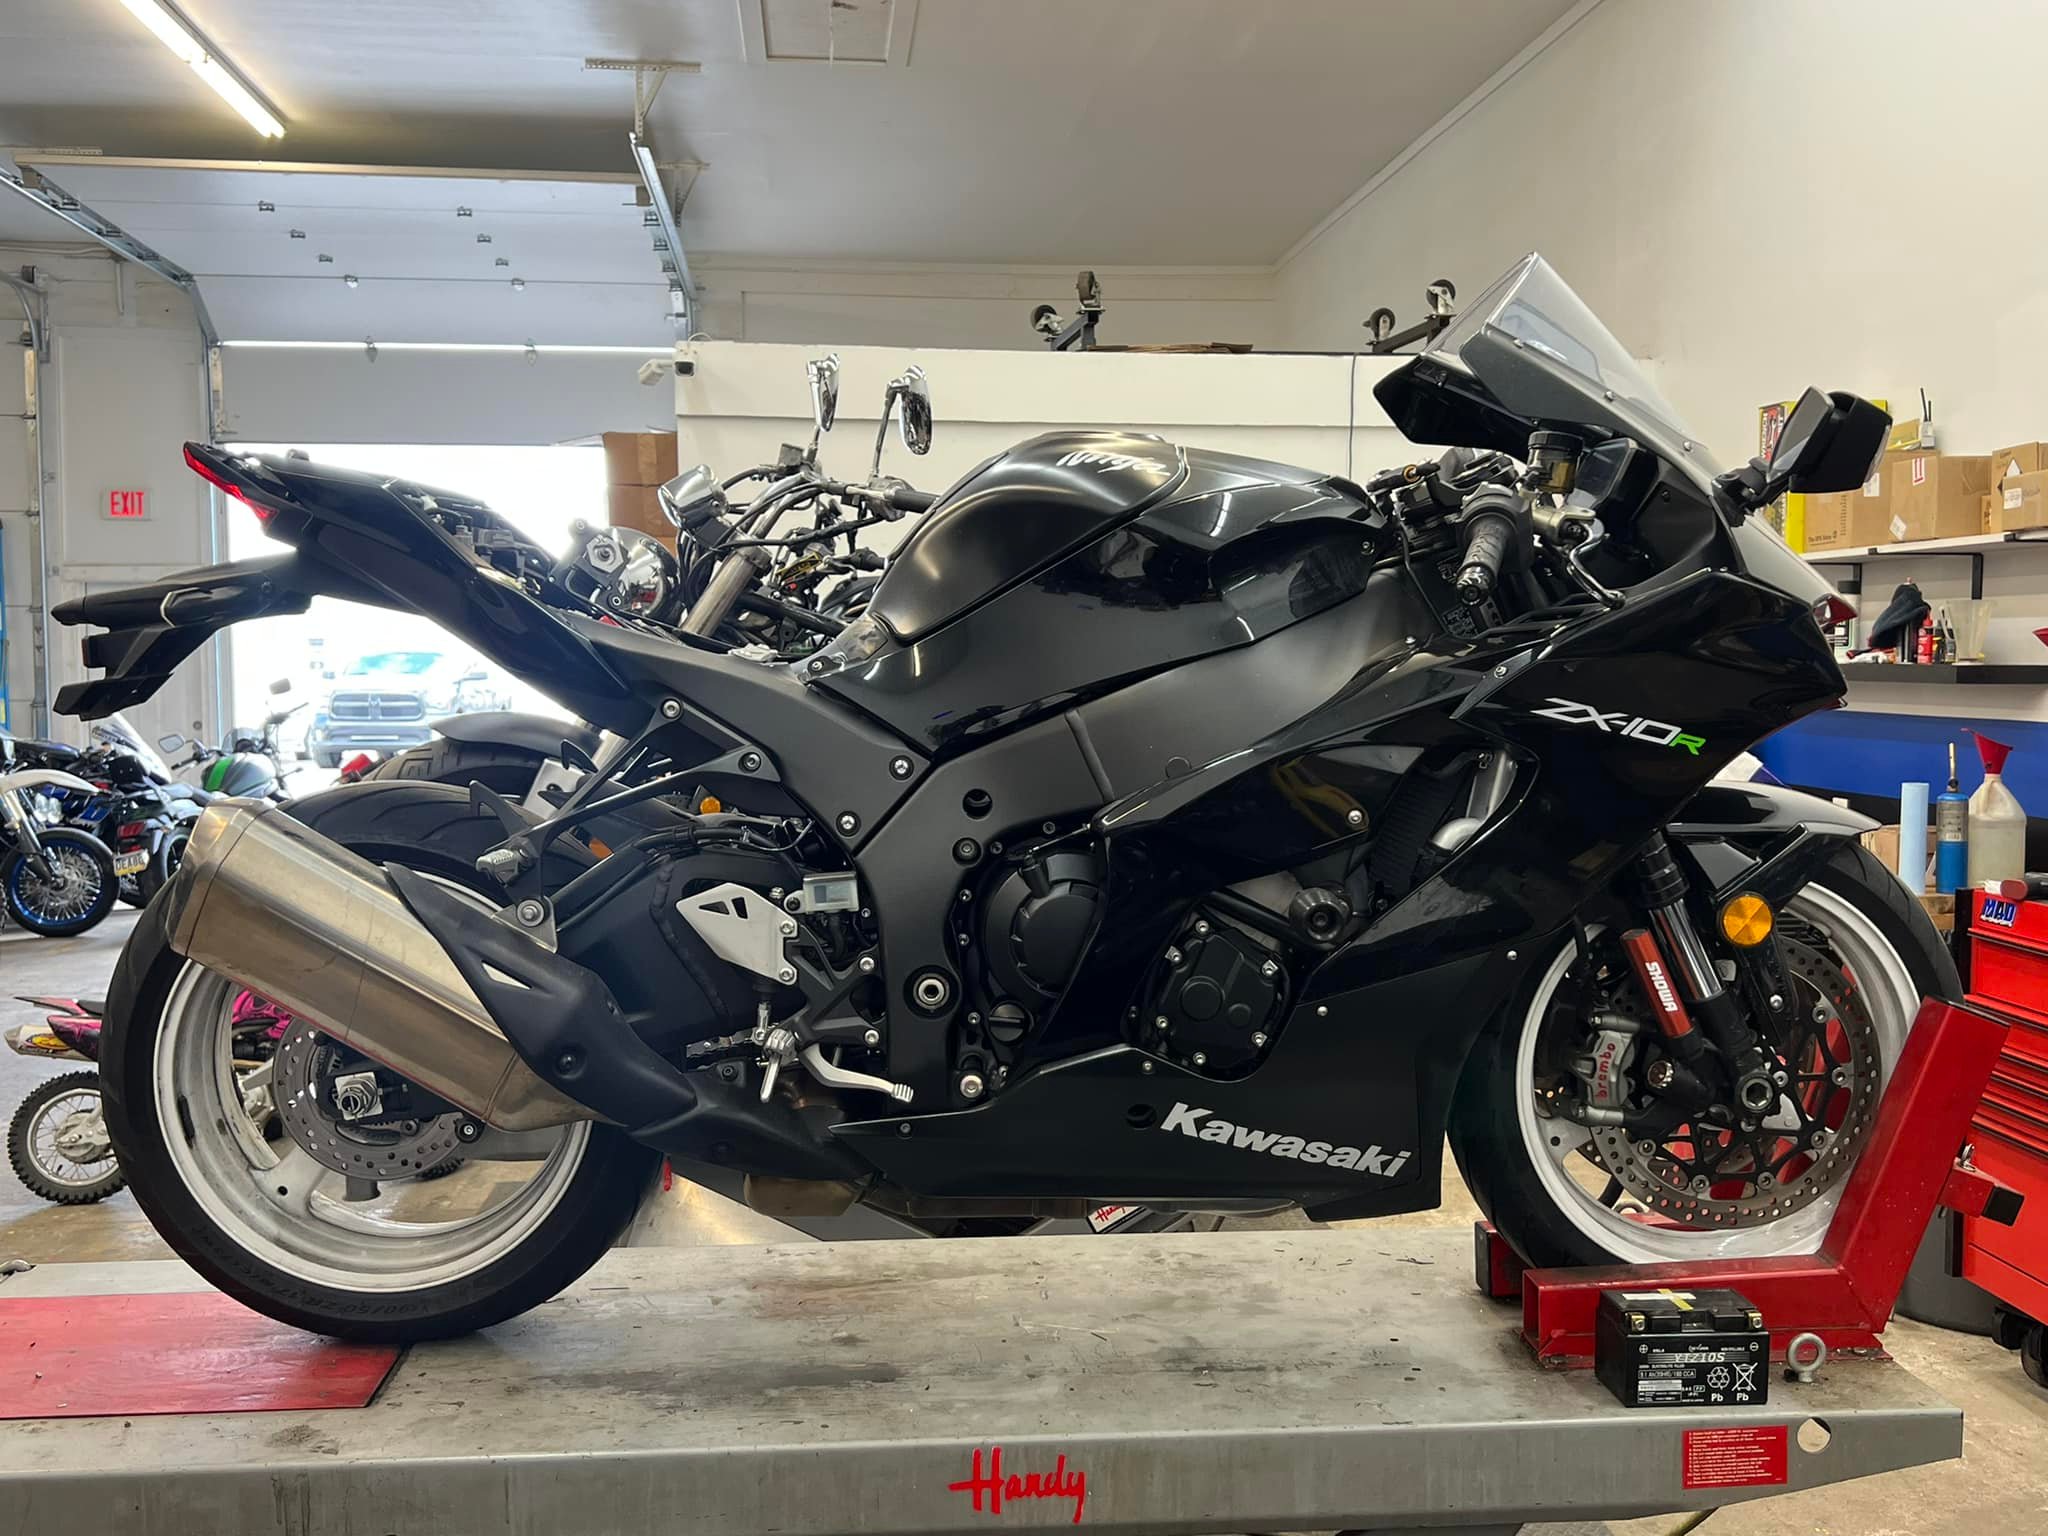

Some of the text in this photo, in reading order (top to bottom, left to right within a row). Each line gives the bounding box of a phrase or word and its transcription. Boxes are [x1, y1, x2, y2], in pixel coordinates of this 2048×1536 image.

[1056, 450, 1171, 476] Ninja
[111, 491, 144, 517] EXIT
[1529, 697, 1706, 755] ZX-10R
[1645, 961, 1678, 1012] SHOWA
[1596, 1042, 1616, 1099] brembo
[1160, 1101, 1411, 1177] Kawasaki
[1674, 1352, 1726, 1363] YTZ10S
[1711, 1393, 1724, 1402] Pb
[1736, 1392, 1749, 1402] Pb
[947, 1446, 1086, 1524] Handy
